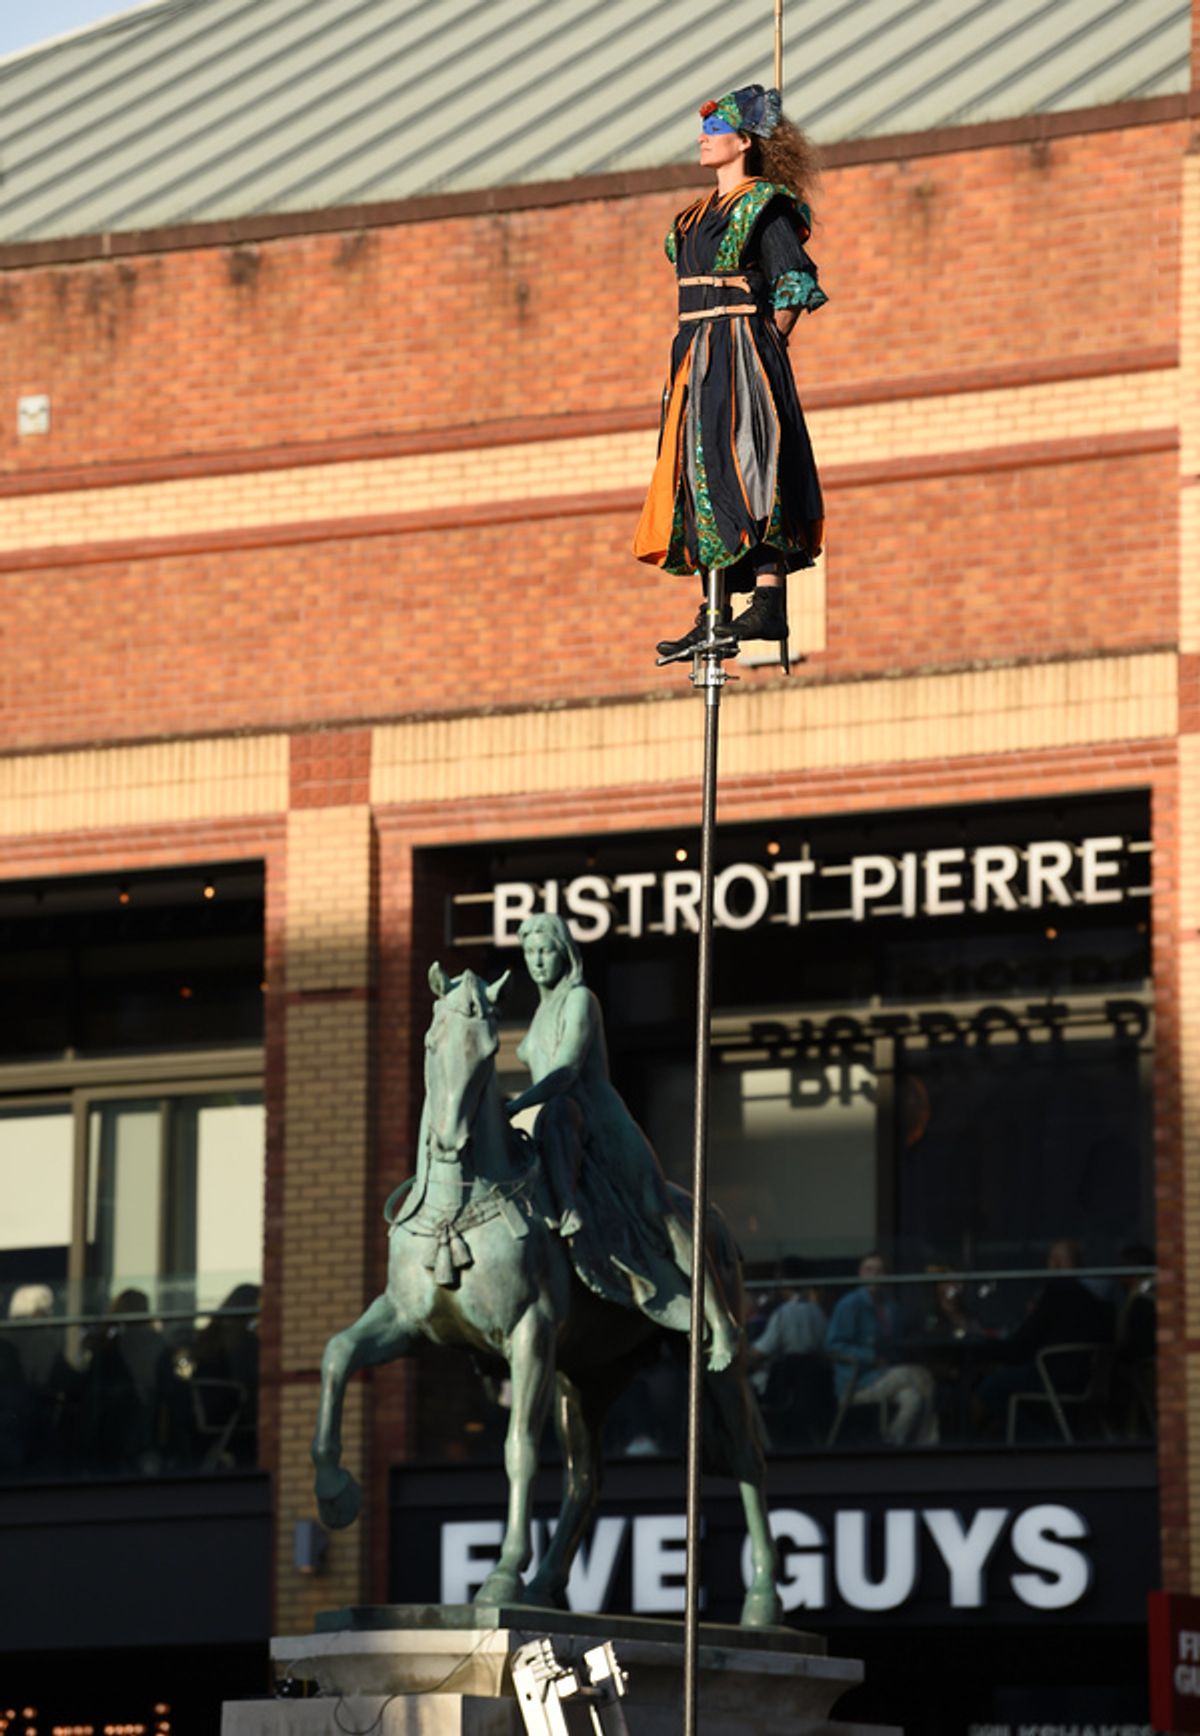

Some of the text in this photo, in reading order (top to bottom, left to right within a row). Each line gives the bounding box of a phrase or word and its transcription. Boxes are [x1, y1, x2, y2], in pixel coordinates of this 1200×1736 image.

[492, 836, 1124, 948] BISTROT PIERRE
[740, 1503, 1092, 1612] GUYS
